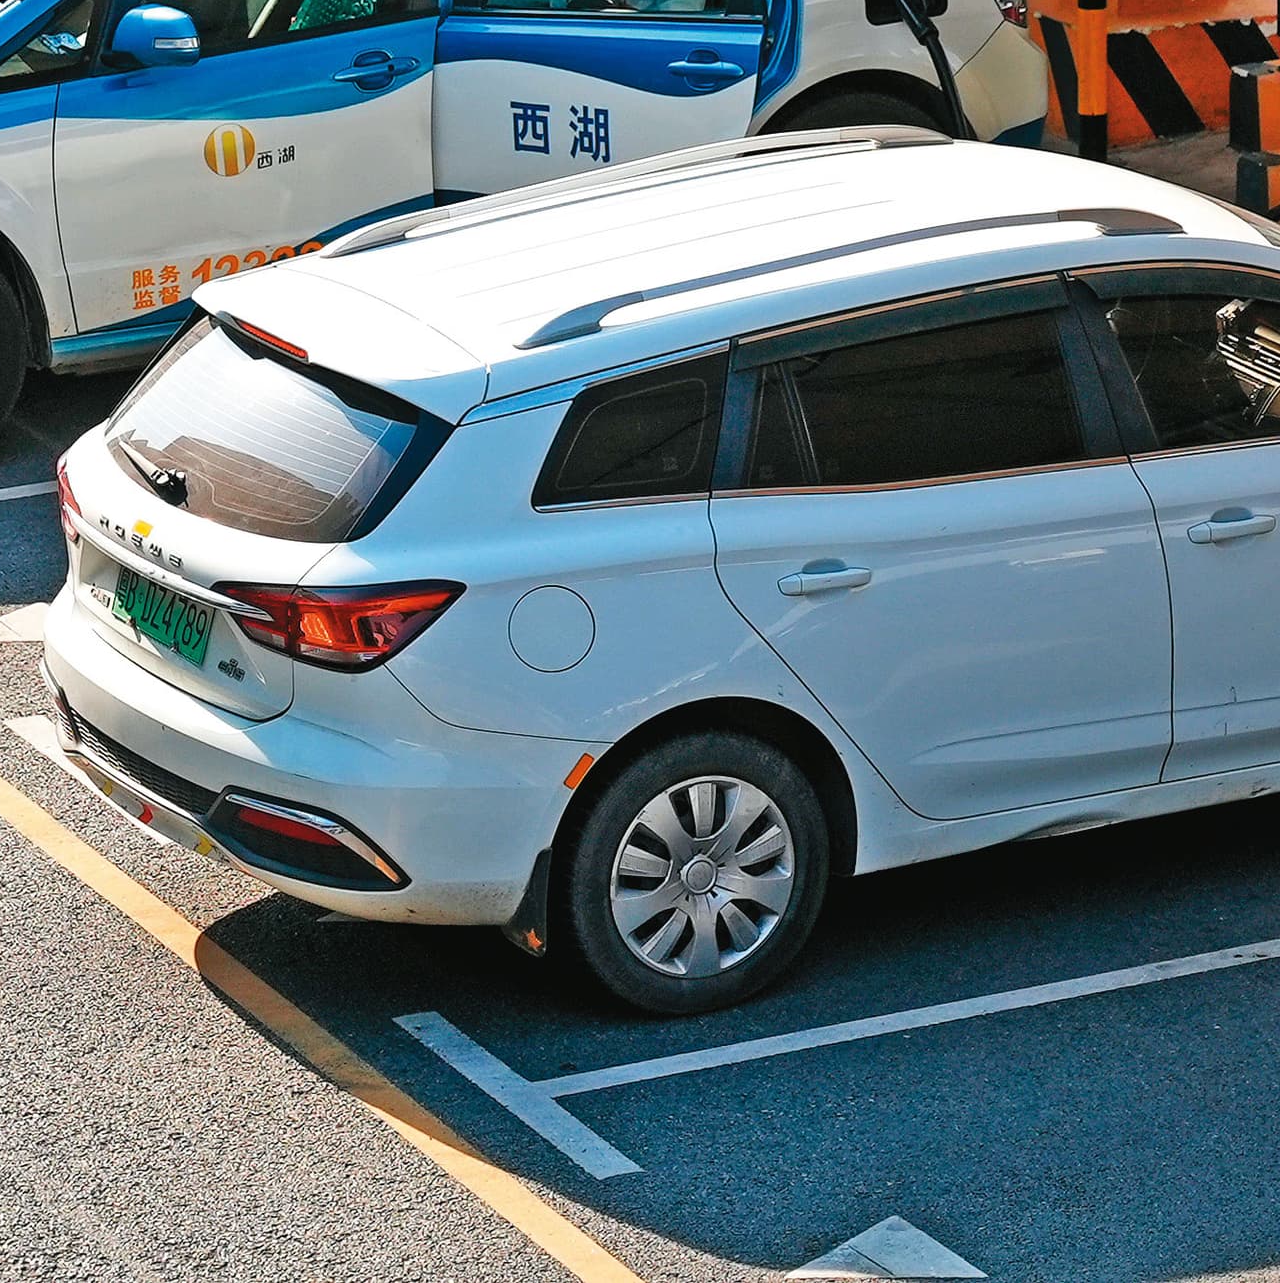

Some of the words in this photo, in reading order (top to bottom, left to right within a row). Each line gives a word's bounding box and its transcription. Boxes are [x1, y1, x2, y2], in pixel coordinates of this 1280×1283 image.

[509, 100, 611, 163] 西湖
[257, 146, 295, 170] 西湖
[132, 264, 181, 290] 服务
[133, 285, 182, 310] 监督
